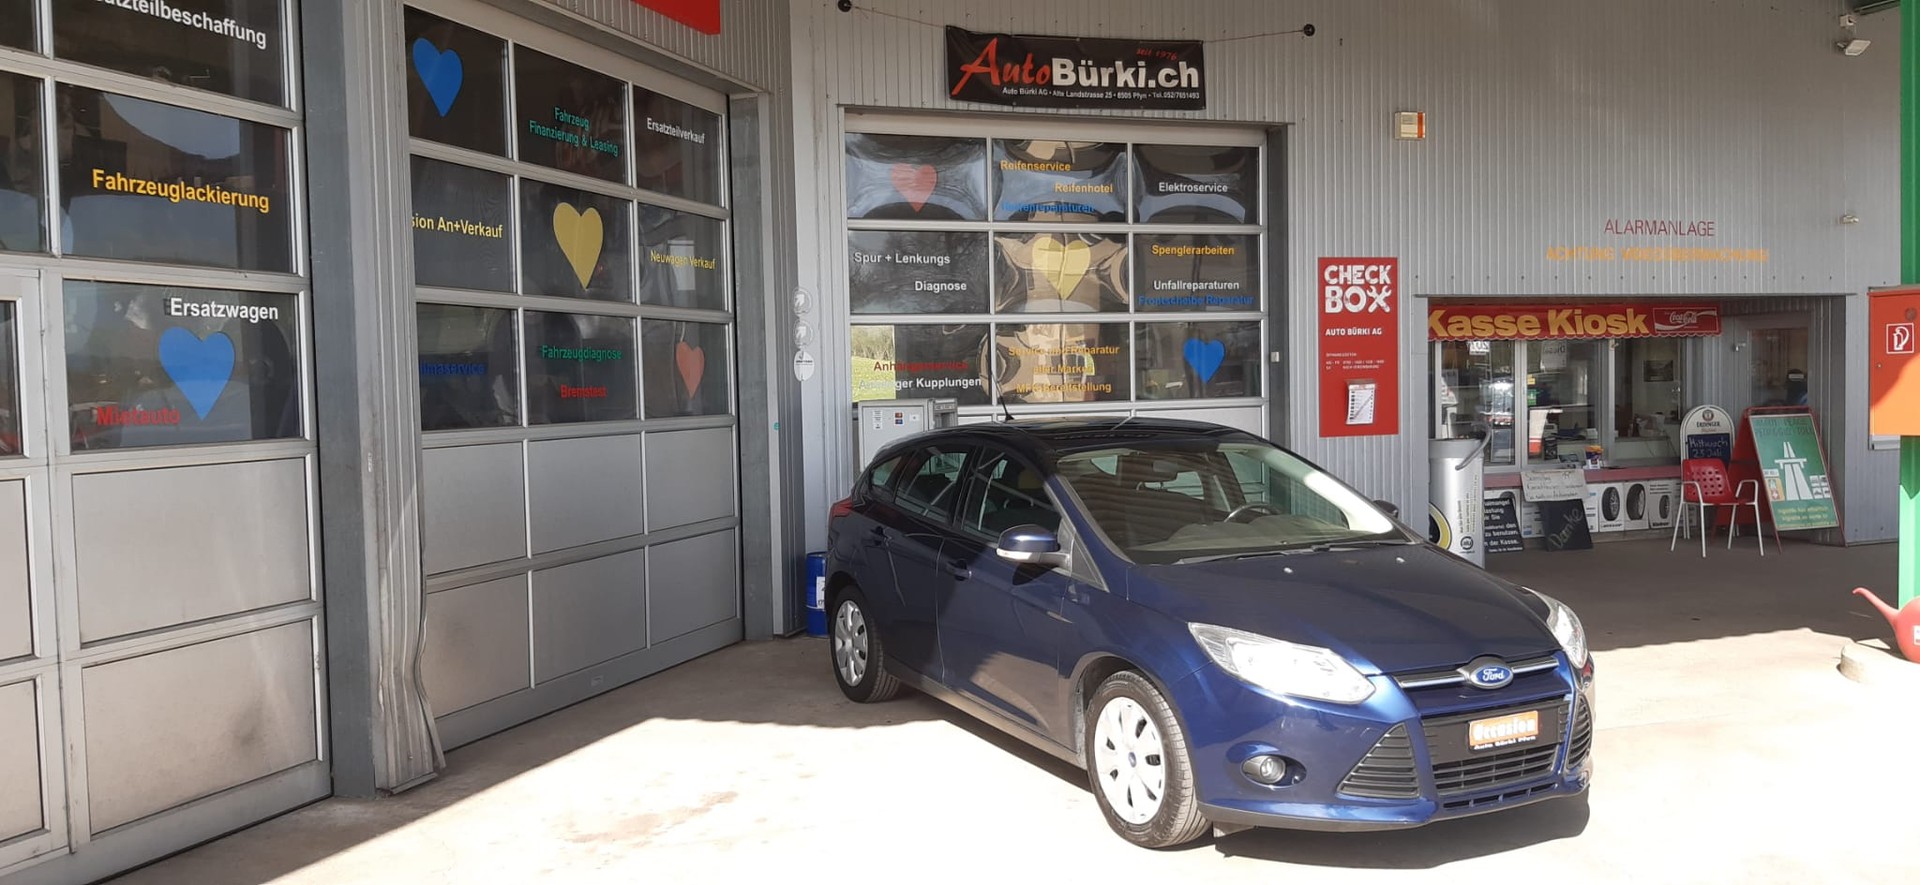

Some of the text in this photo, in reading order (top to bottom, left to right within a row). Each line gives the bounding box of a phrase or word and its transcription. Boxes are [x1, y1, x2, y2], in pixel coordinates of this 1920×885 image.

[1003, 87, 1018, 95] Auto
[1038, 88, 1048, 96] AG
[1066, 90, 1104, 99] Landstrasse
[554, 107, 590, 131] Fahrzeug
[529, 119, 619, 157] Finanzierung & Leasing
[647, 117, 705, 145] Ersatzteilverkauf
[1000, 160, 1071, 172] Reifenservice
[92, 168, 269, 214] Fahrzeuglackierung
[1055, 182, 1113, 194] Reifenhotel
[1159, 182, 1228, 193] Elektroservice
[437, 217, 503, 238] An+Verkauf
[1604, 218, 1715, 237] ALARMANLAGE
[650, 250, 716, 270] Neuwagen Verkauf
[854, 252, 950, 266] Spur + Lenkungs
[1152, 245, 1235, 257] Spenglerarbeiten
[1547, 245, 1615, 261] ACHTUNG
[1324, 265, 1391, 285] CHECK
[914, 281, 967, 294] Diagnose
[1154, 280, 1239, 292] Unfallreparaturen
[1325, 285, 1391, 313] BOX
[170, 297, 279, 323] Ersatzwagen
[1325, 327, 1382, 336] AUTO BÜRKI AG
[1428, 308, 1650, 337] Kasse Kiosk
[542, 345, 622, 362] Fahrzeugdiagnose
[916, 377, 982, 389] Kupplungen
[96, 405, 181, 426] Mietauto
[1482, 668, 1504, 682] Ford
[1473, 717, 1536, 741] Occasion
